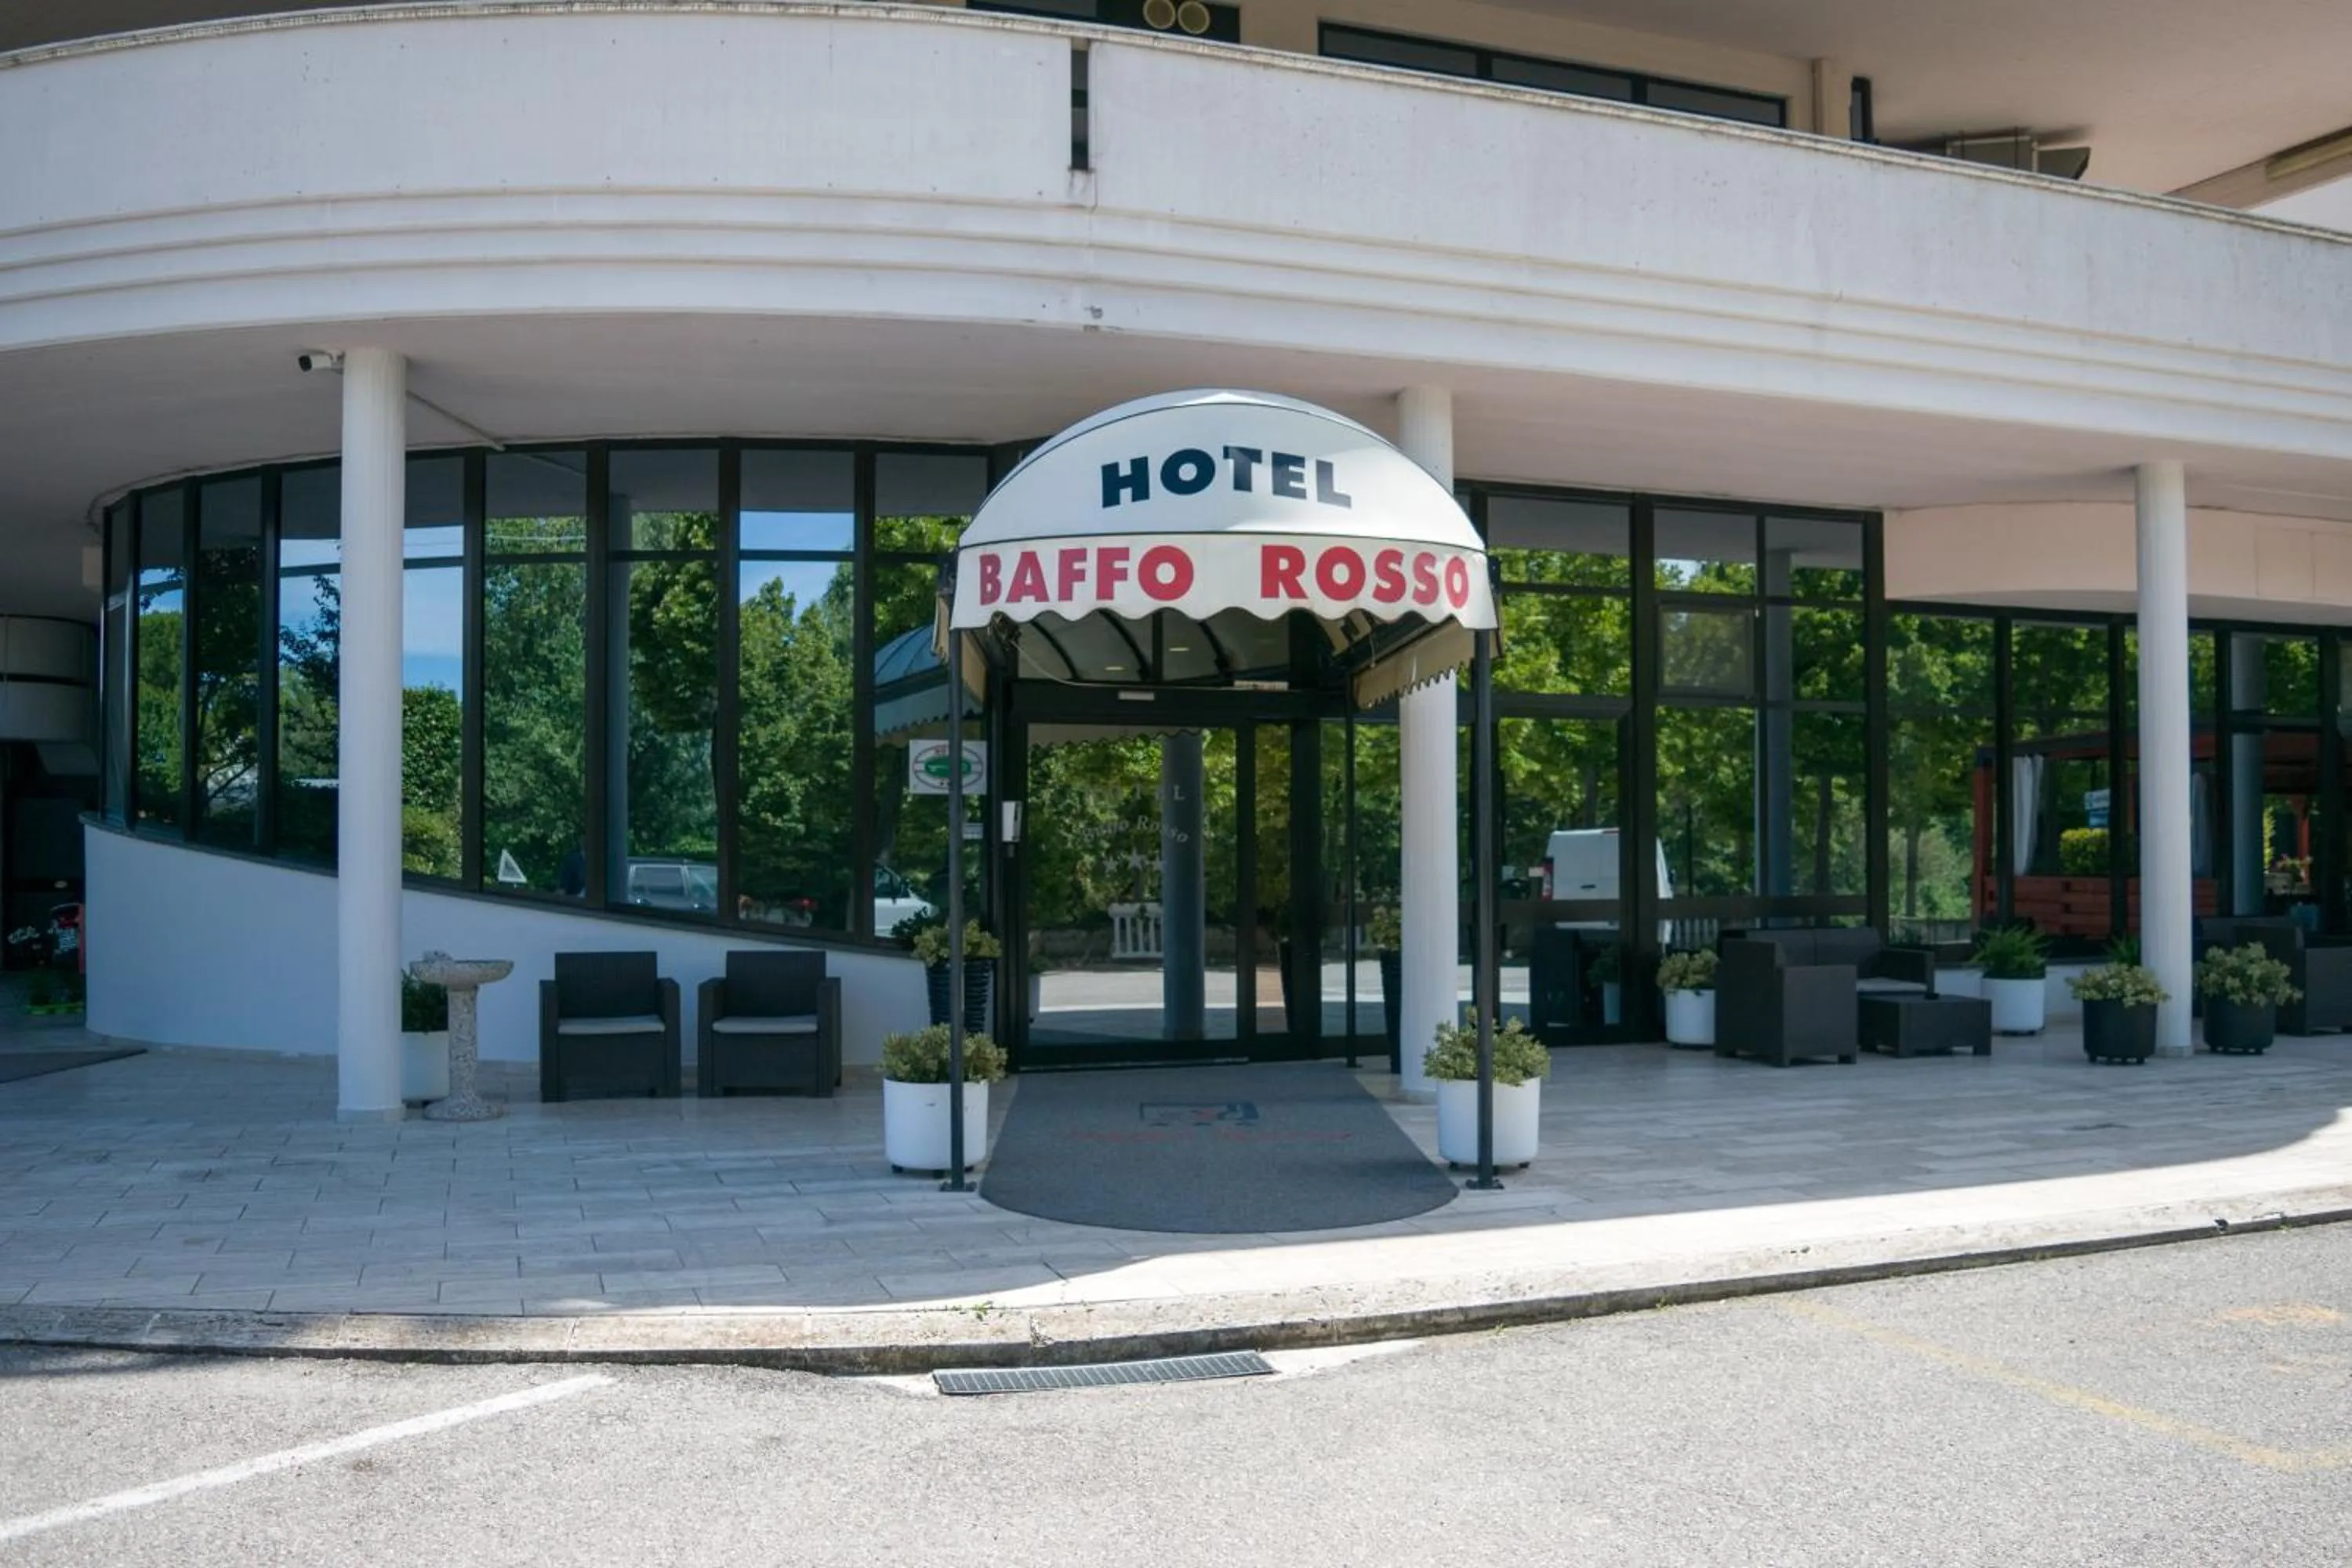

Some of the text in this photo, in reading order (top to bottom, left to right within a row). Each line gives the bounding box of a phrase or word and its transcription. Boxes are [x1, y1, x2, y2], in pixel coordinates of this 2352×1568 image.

[1102, 445, 1352, 508] HOTEL
[979, 544, 1469, 609] BAFFO ROSSO
